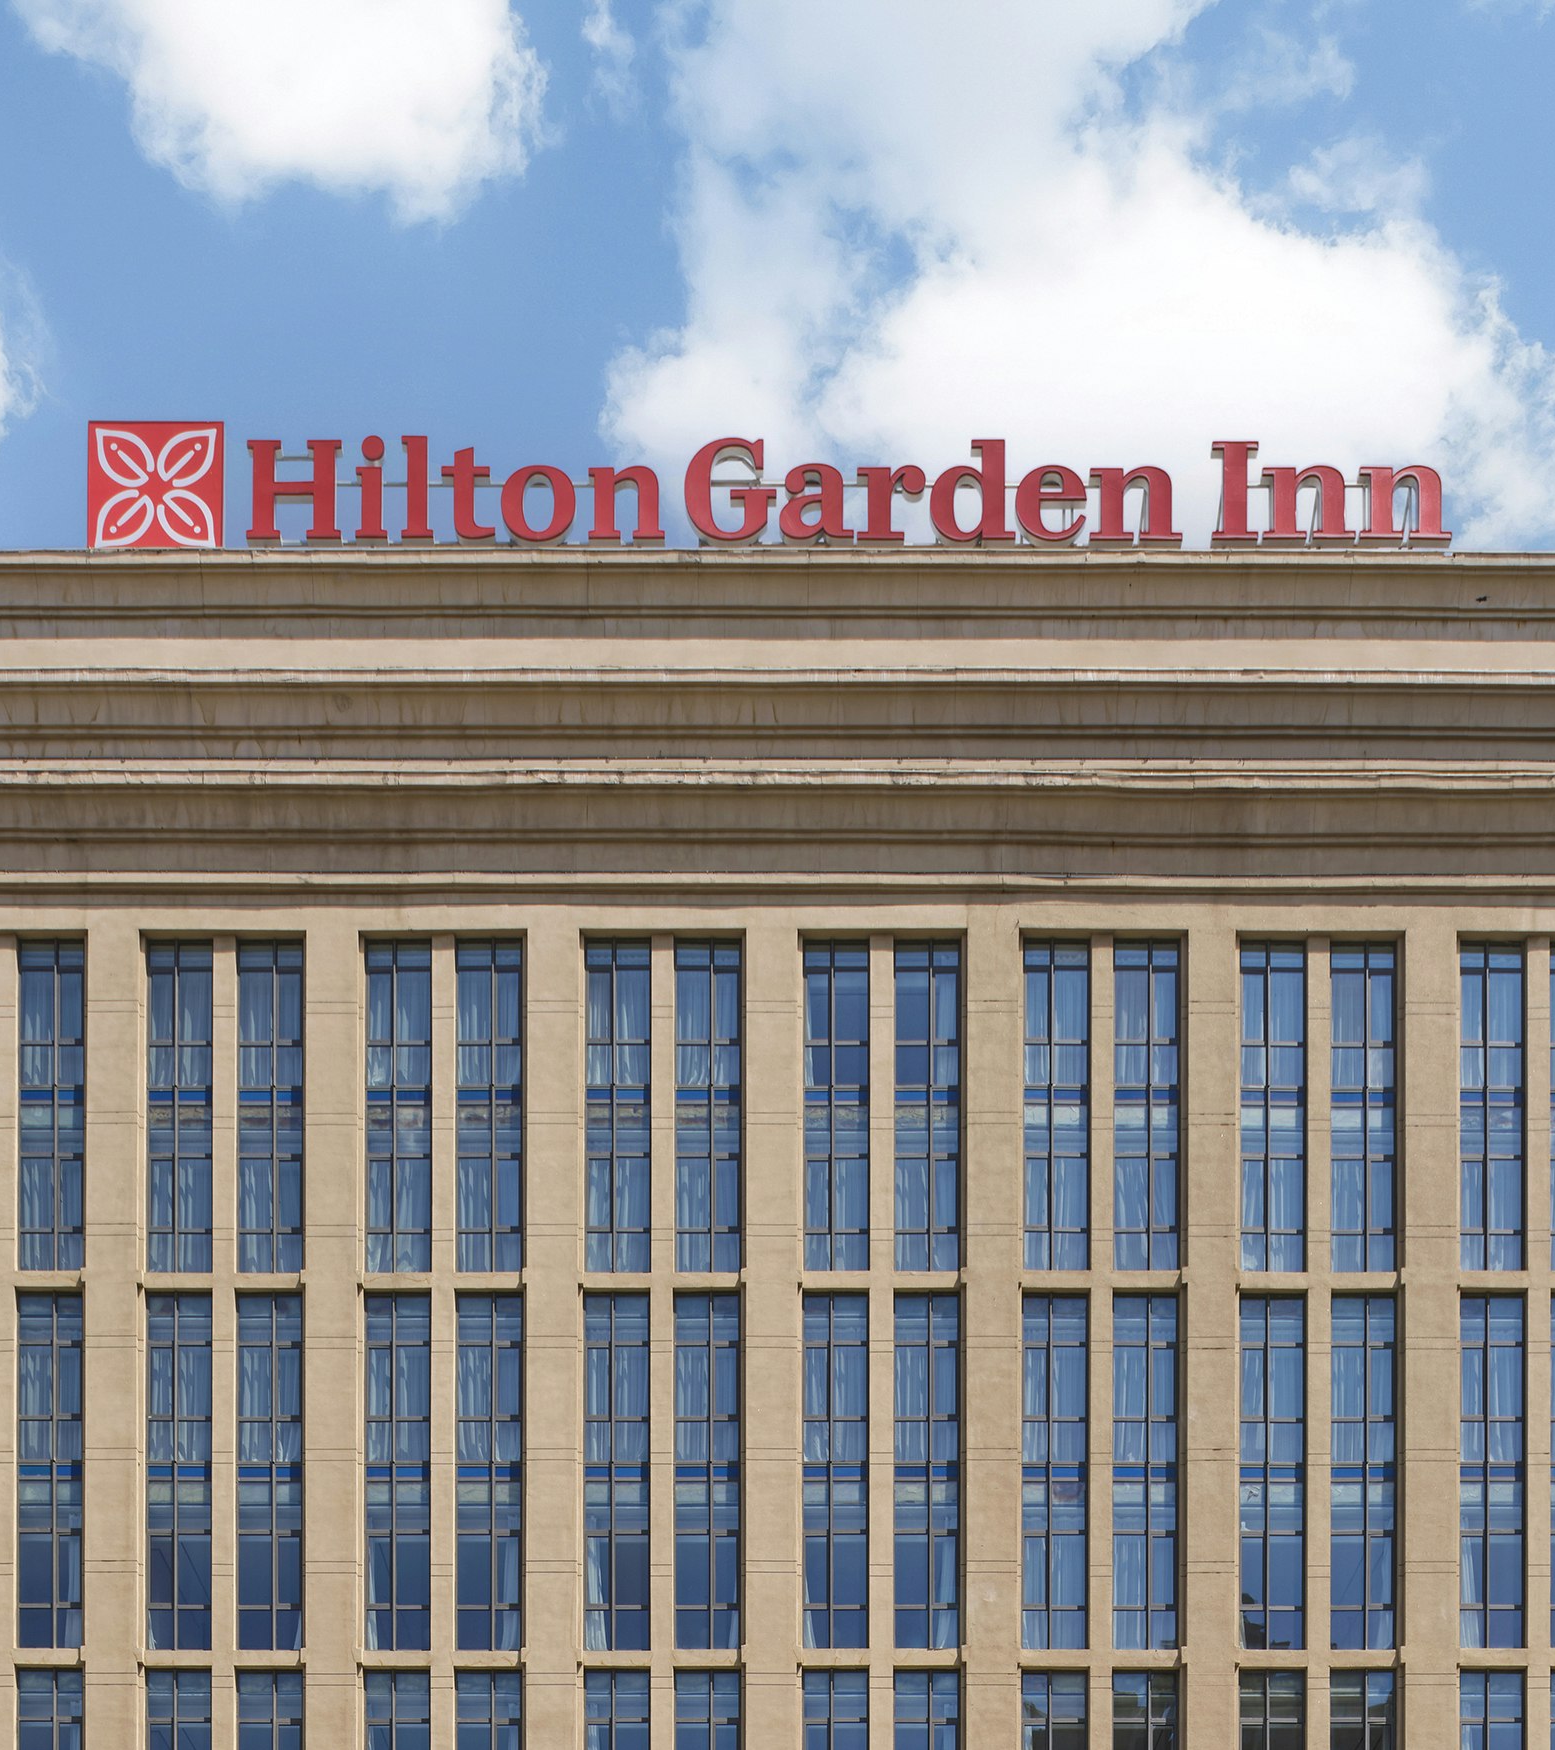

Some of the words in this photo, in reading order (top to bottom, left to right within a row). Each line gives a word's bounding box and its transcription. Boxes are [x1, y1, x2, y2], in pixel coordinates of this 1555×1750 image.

[246, 435, 666, 547] Hilton
[684, 437, 1183, 548] Garden
[1211, 440, 1452, 548] Inn
